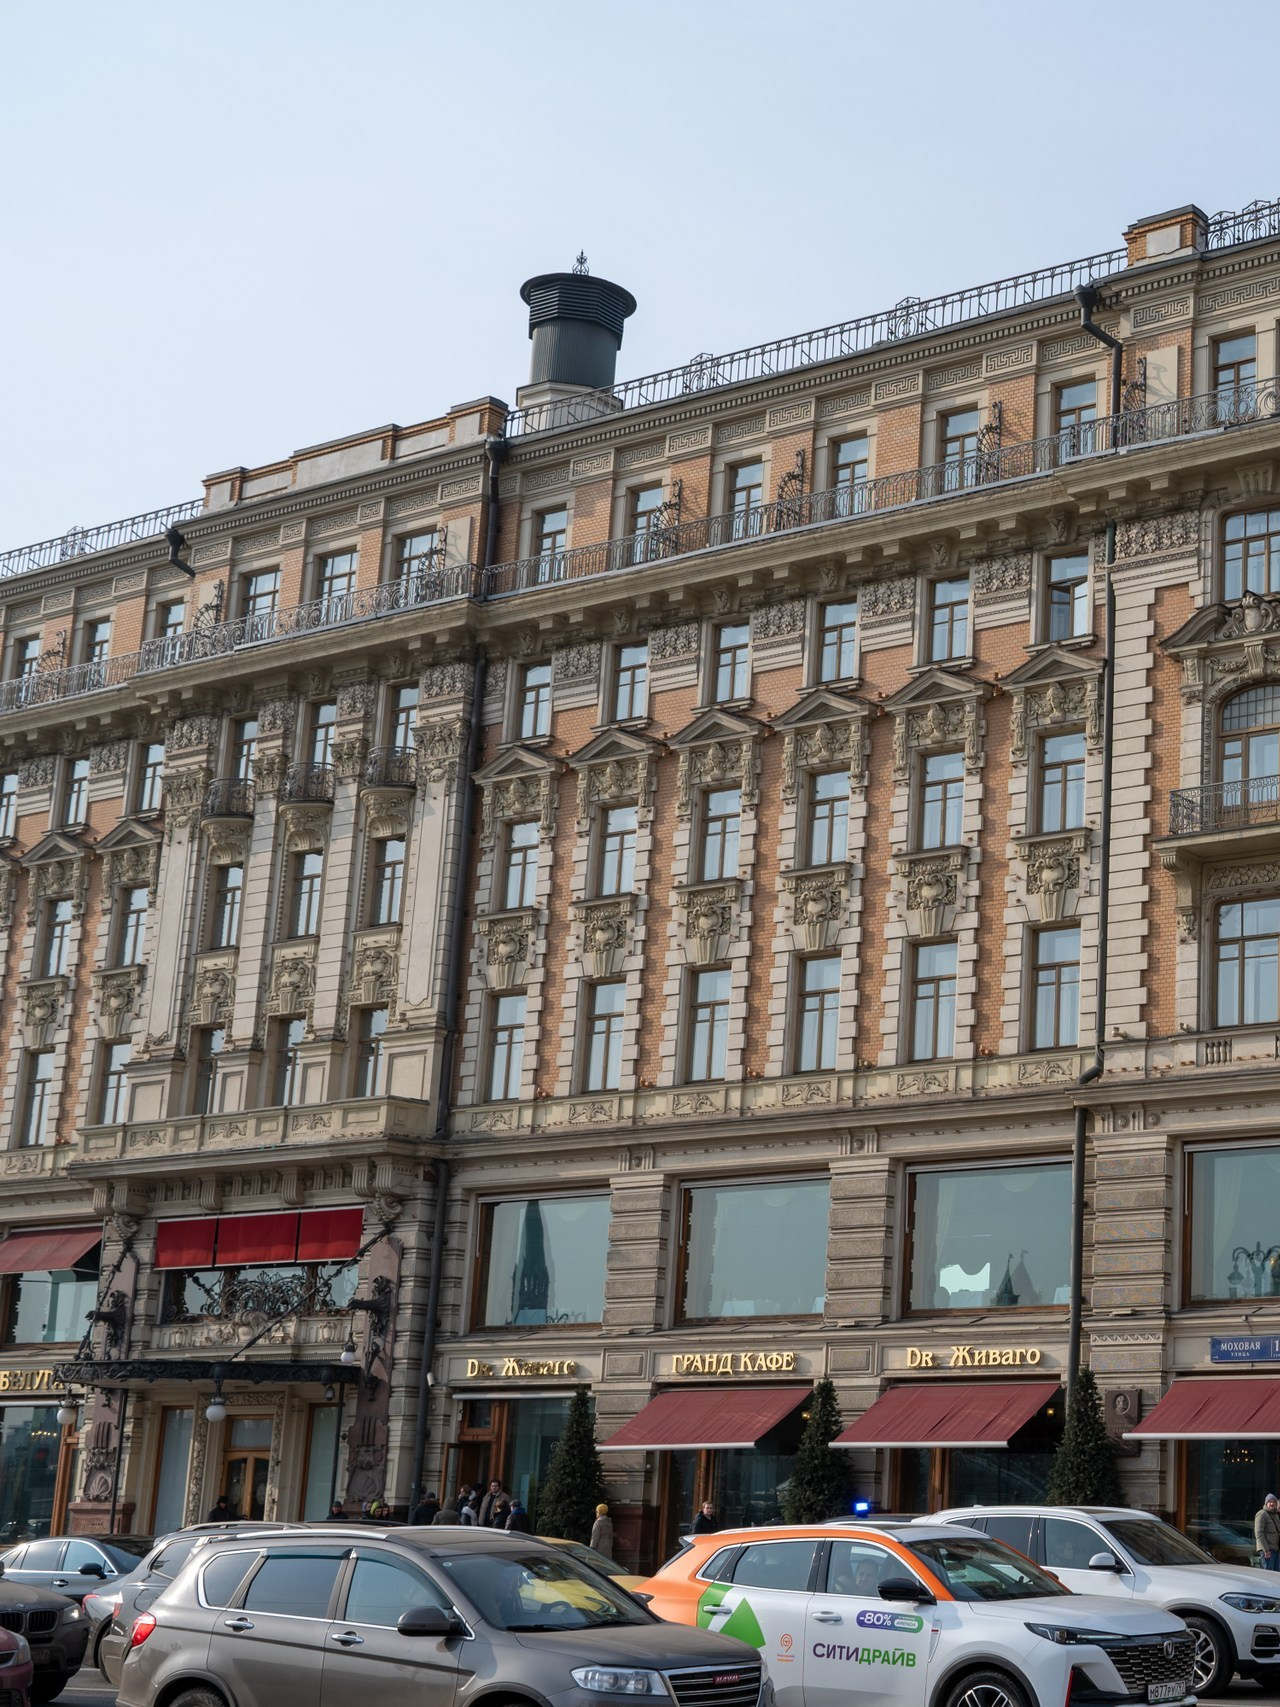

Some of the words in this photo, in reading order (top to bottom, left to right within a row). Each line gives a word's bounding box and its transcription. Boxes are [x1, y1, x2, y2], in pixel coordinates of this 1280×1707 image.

[949, 1345, 1041, 1366] Живаго
[1220, 1341, 1261, 1351] МОХОВАЯ
[672, 1353, 733, 1376] ГРАНД
[740, 1352, 795, 1372] КАФЕ
[859, 1612, 892, 1626] -80%
[813, 1643, 917, 1668] СИТИДРАЙВ
